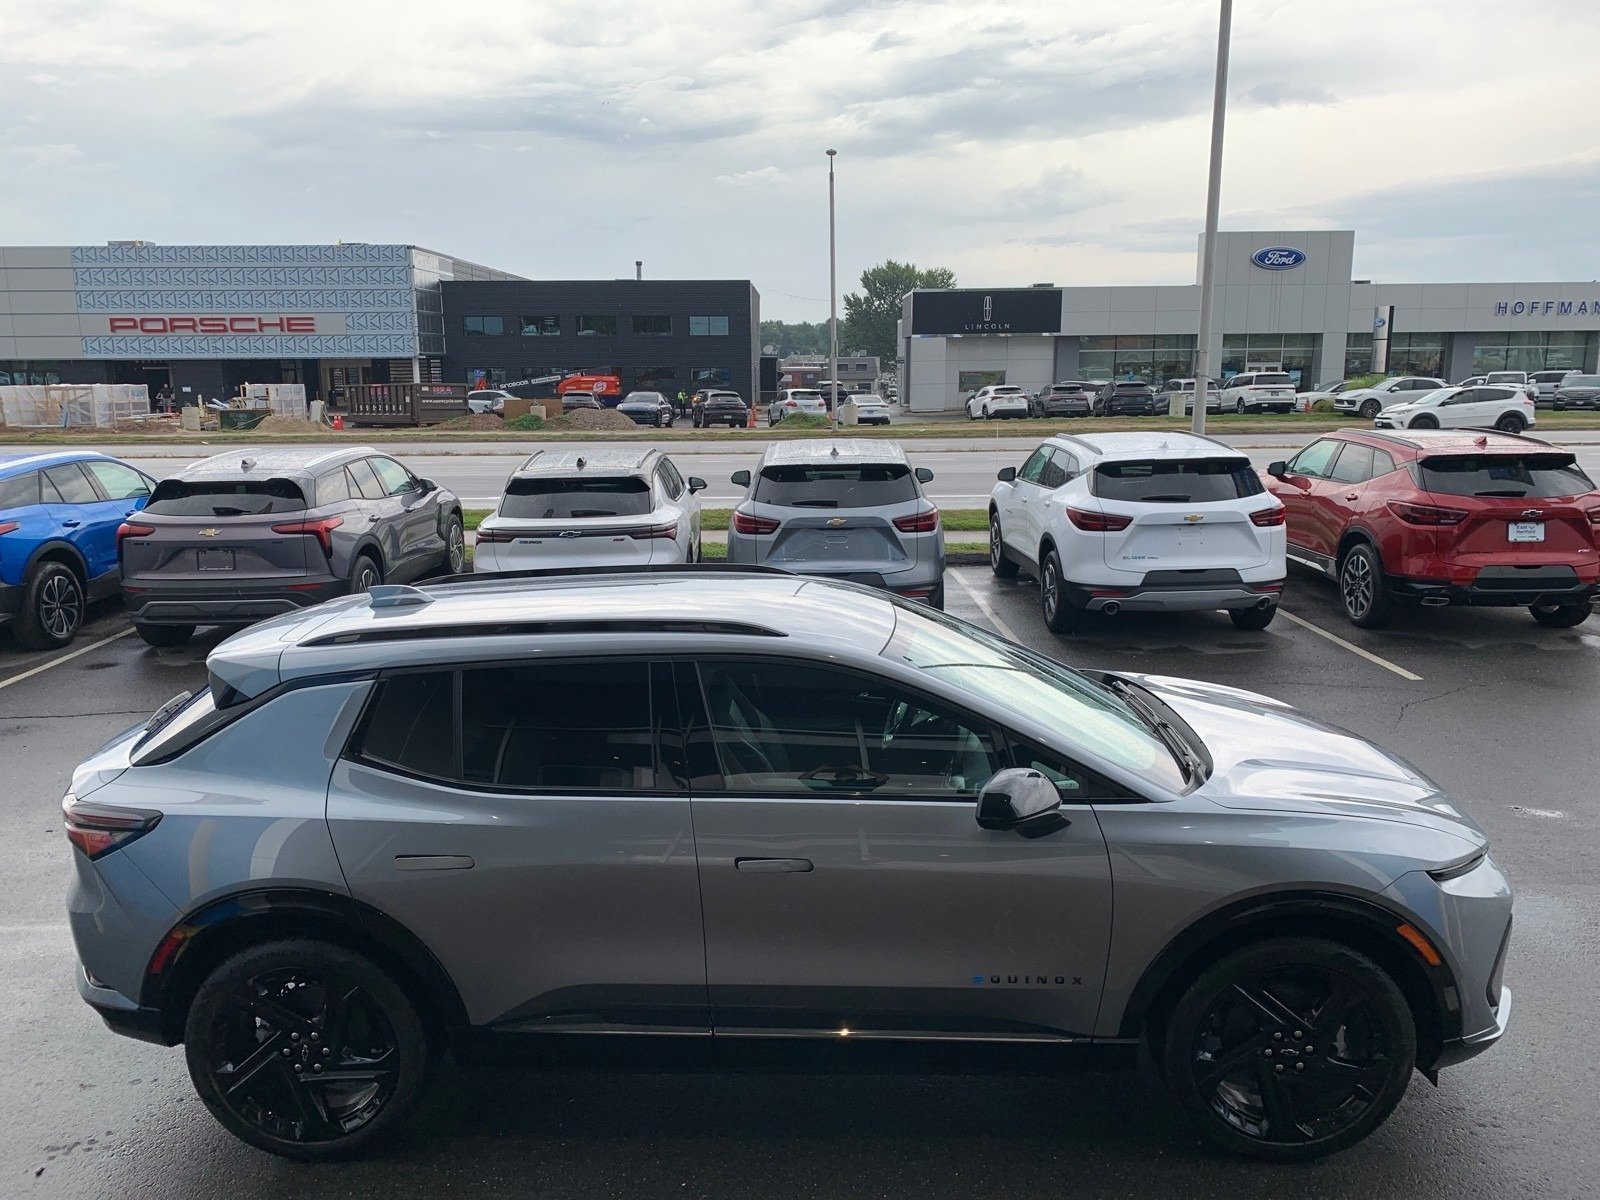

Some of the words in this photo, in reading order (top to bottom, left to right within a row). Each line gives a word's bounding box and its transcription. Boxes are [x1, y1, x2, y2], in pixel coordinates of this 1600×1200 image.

[1264, 251, 1295, 266] Ford
[108, 316, 315, 333] PORSCHE
[972, 975, 1082, 985] EQUINOX
